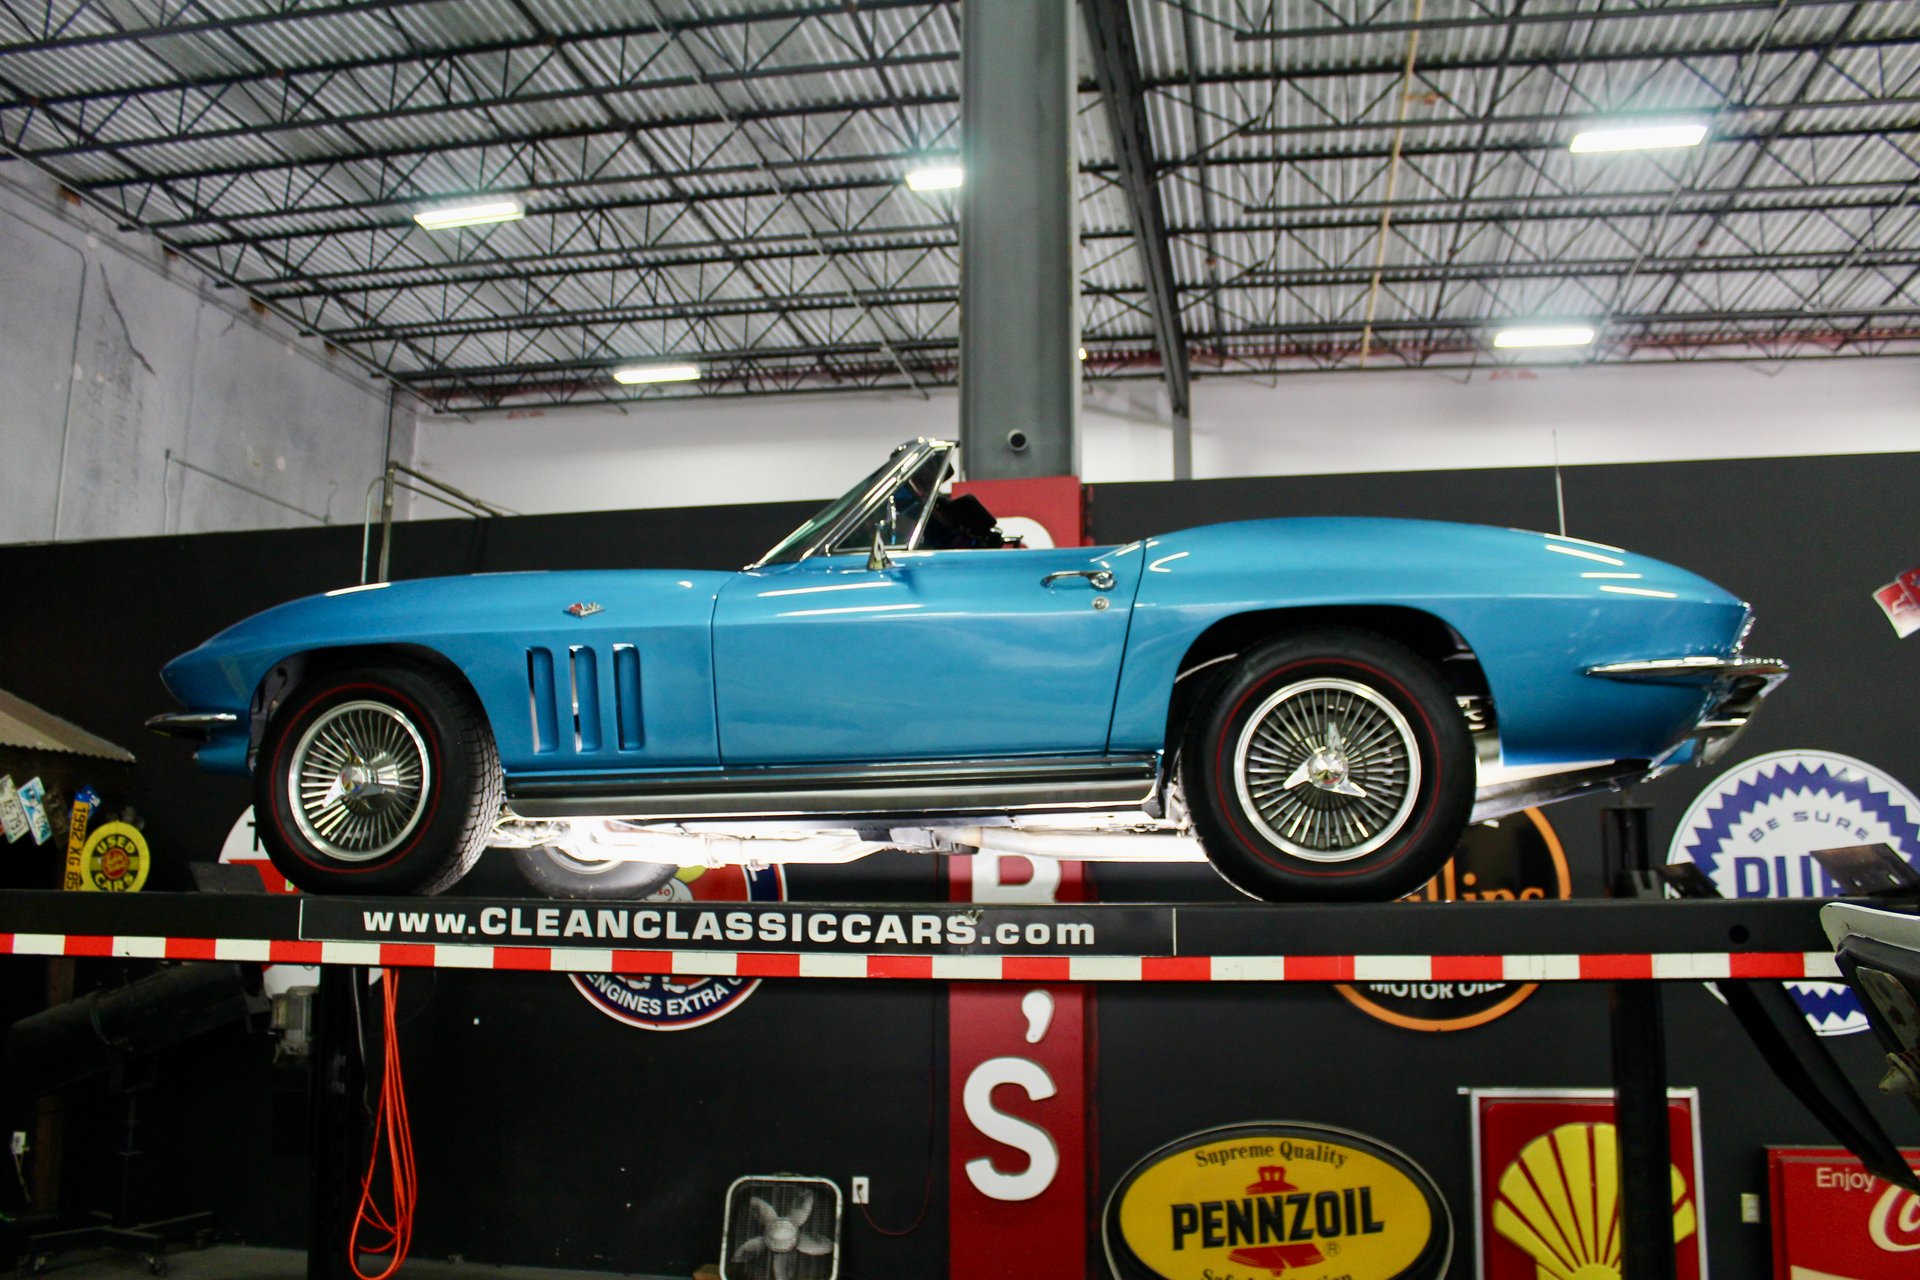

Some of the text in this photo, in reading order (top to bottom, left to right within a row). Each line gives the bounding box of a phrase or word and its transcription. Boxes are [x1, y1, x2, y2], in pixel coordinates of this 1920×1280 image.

[1748, 809, 1870, 844] BE SURE
[96, 835, 136, 855] USED
[95, 872, 135, 892] CARS
[363, 907, 1095, 945] www.CLEANCLASSICCARS.com
[666, 982, 730, 1017] EXTRA
[1369, 983, 1454, 999] MOTOR
[1195, 1140, 1349, 1169] Supreme Quality
[1816, 1167, 1875, 1192] Enjoy
[1170, 1185, 1386, 1251] PENNZOIL
